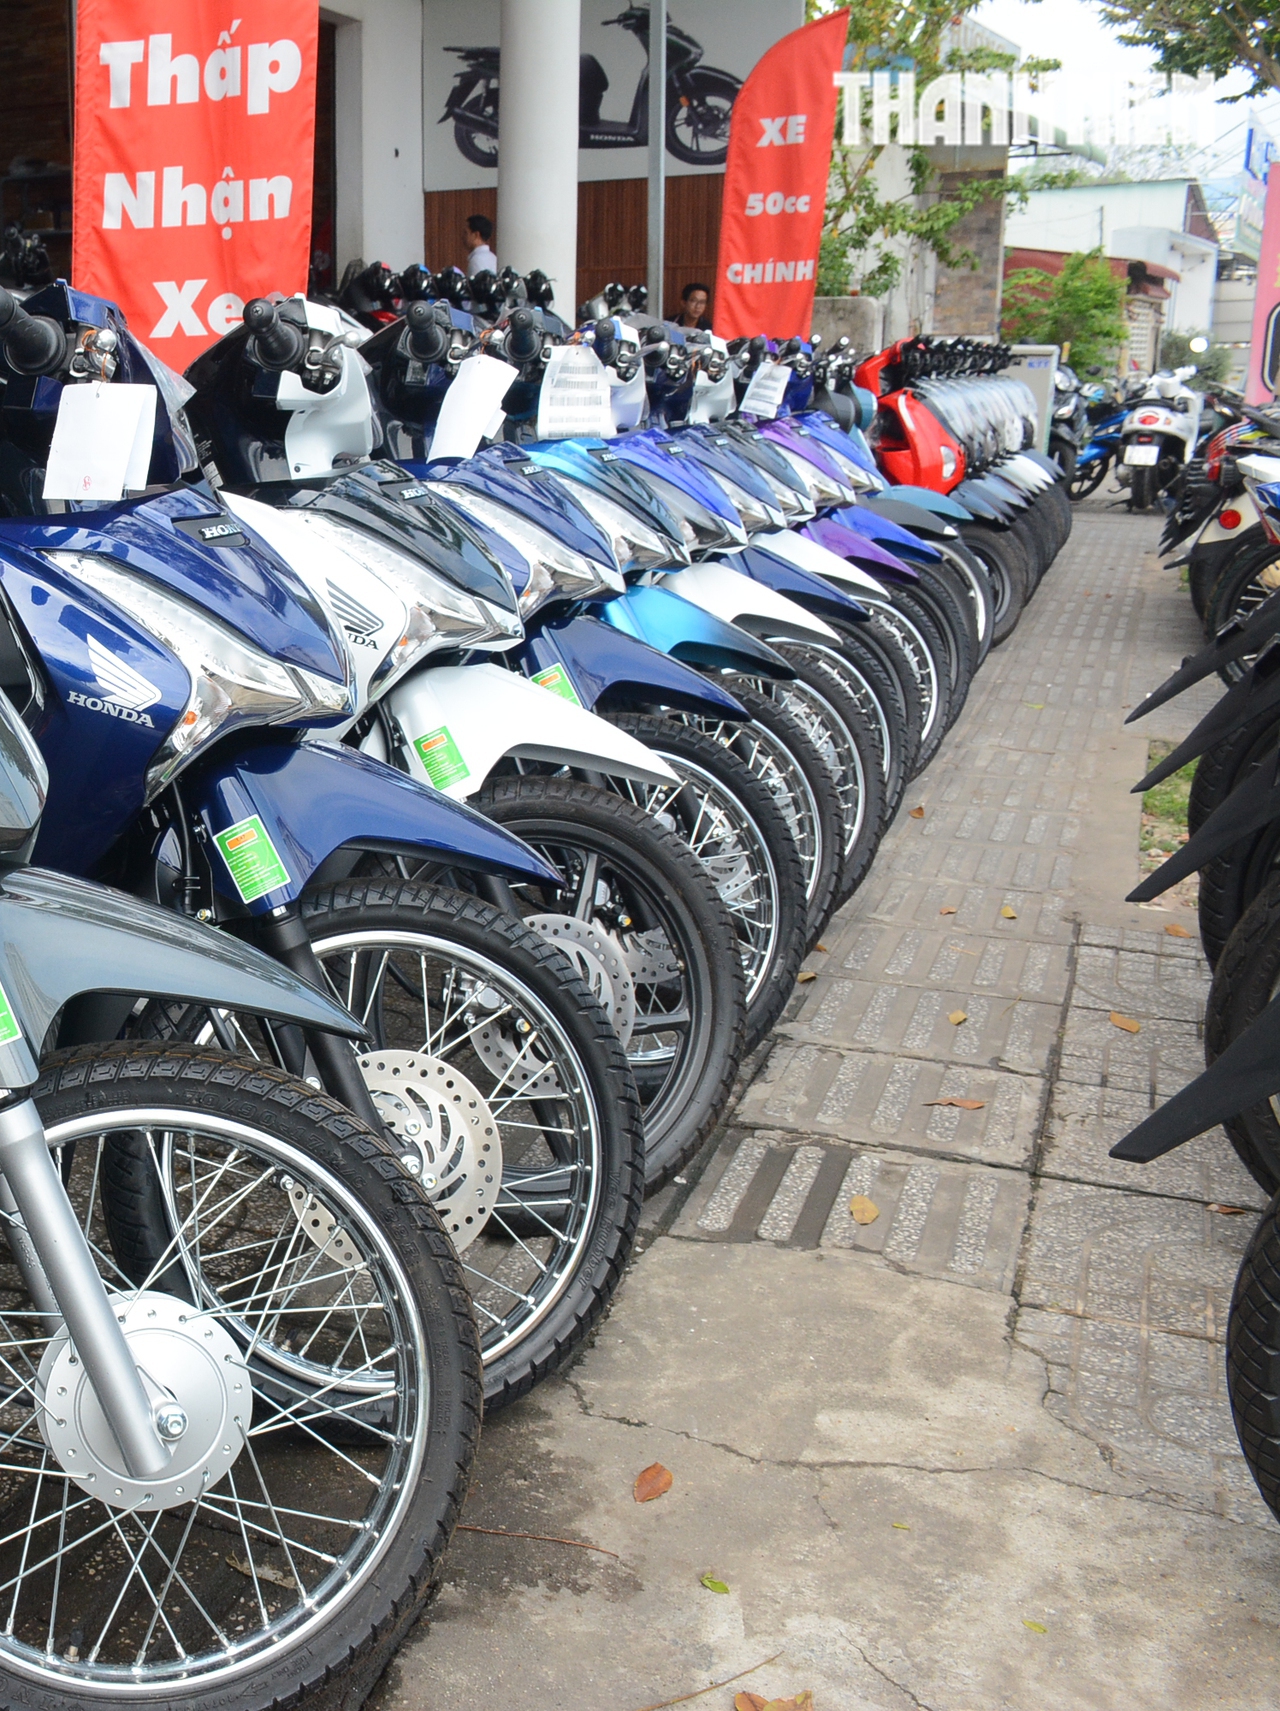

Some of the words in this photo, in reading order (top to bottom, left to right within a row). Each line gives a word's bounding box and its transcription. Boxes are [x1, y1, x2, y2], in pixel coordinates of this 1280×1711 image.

[99, 19, 302, 115] Thấp
[755, 114, 807, 149] XE
[102, 167, 293, 240] Nhận
[745, 192, 811, 217] 50cc
[727, 250, 815, 285] CHÍNH
[149, 279, 246, 339] Xe
[66, 690, 156, 729] HONDA
